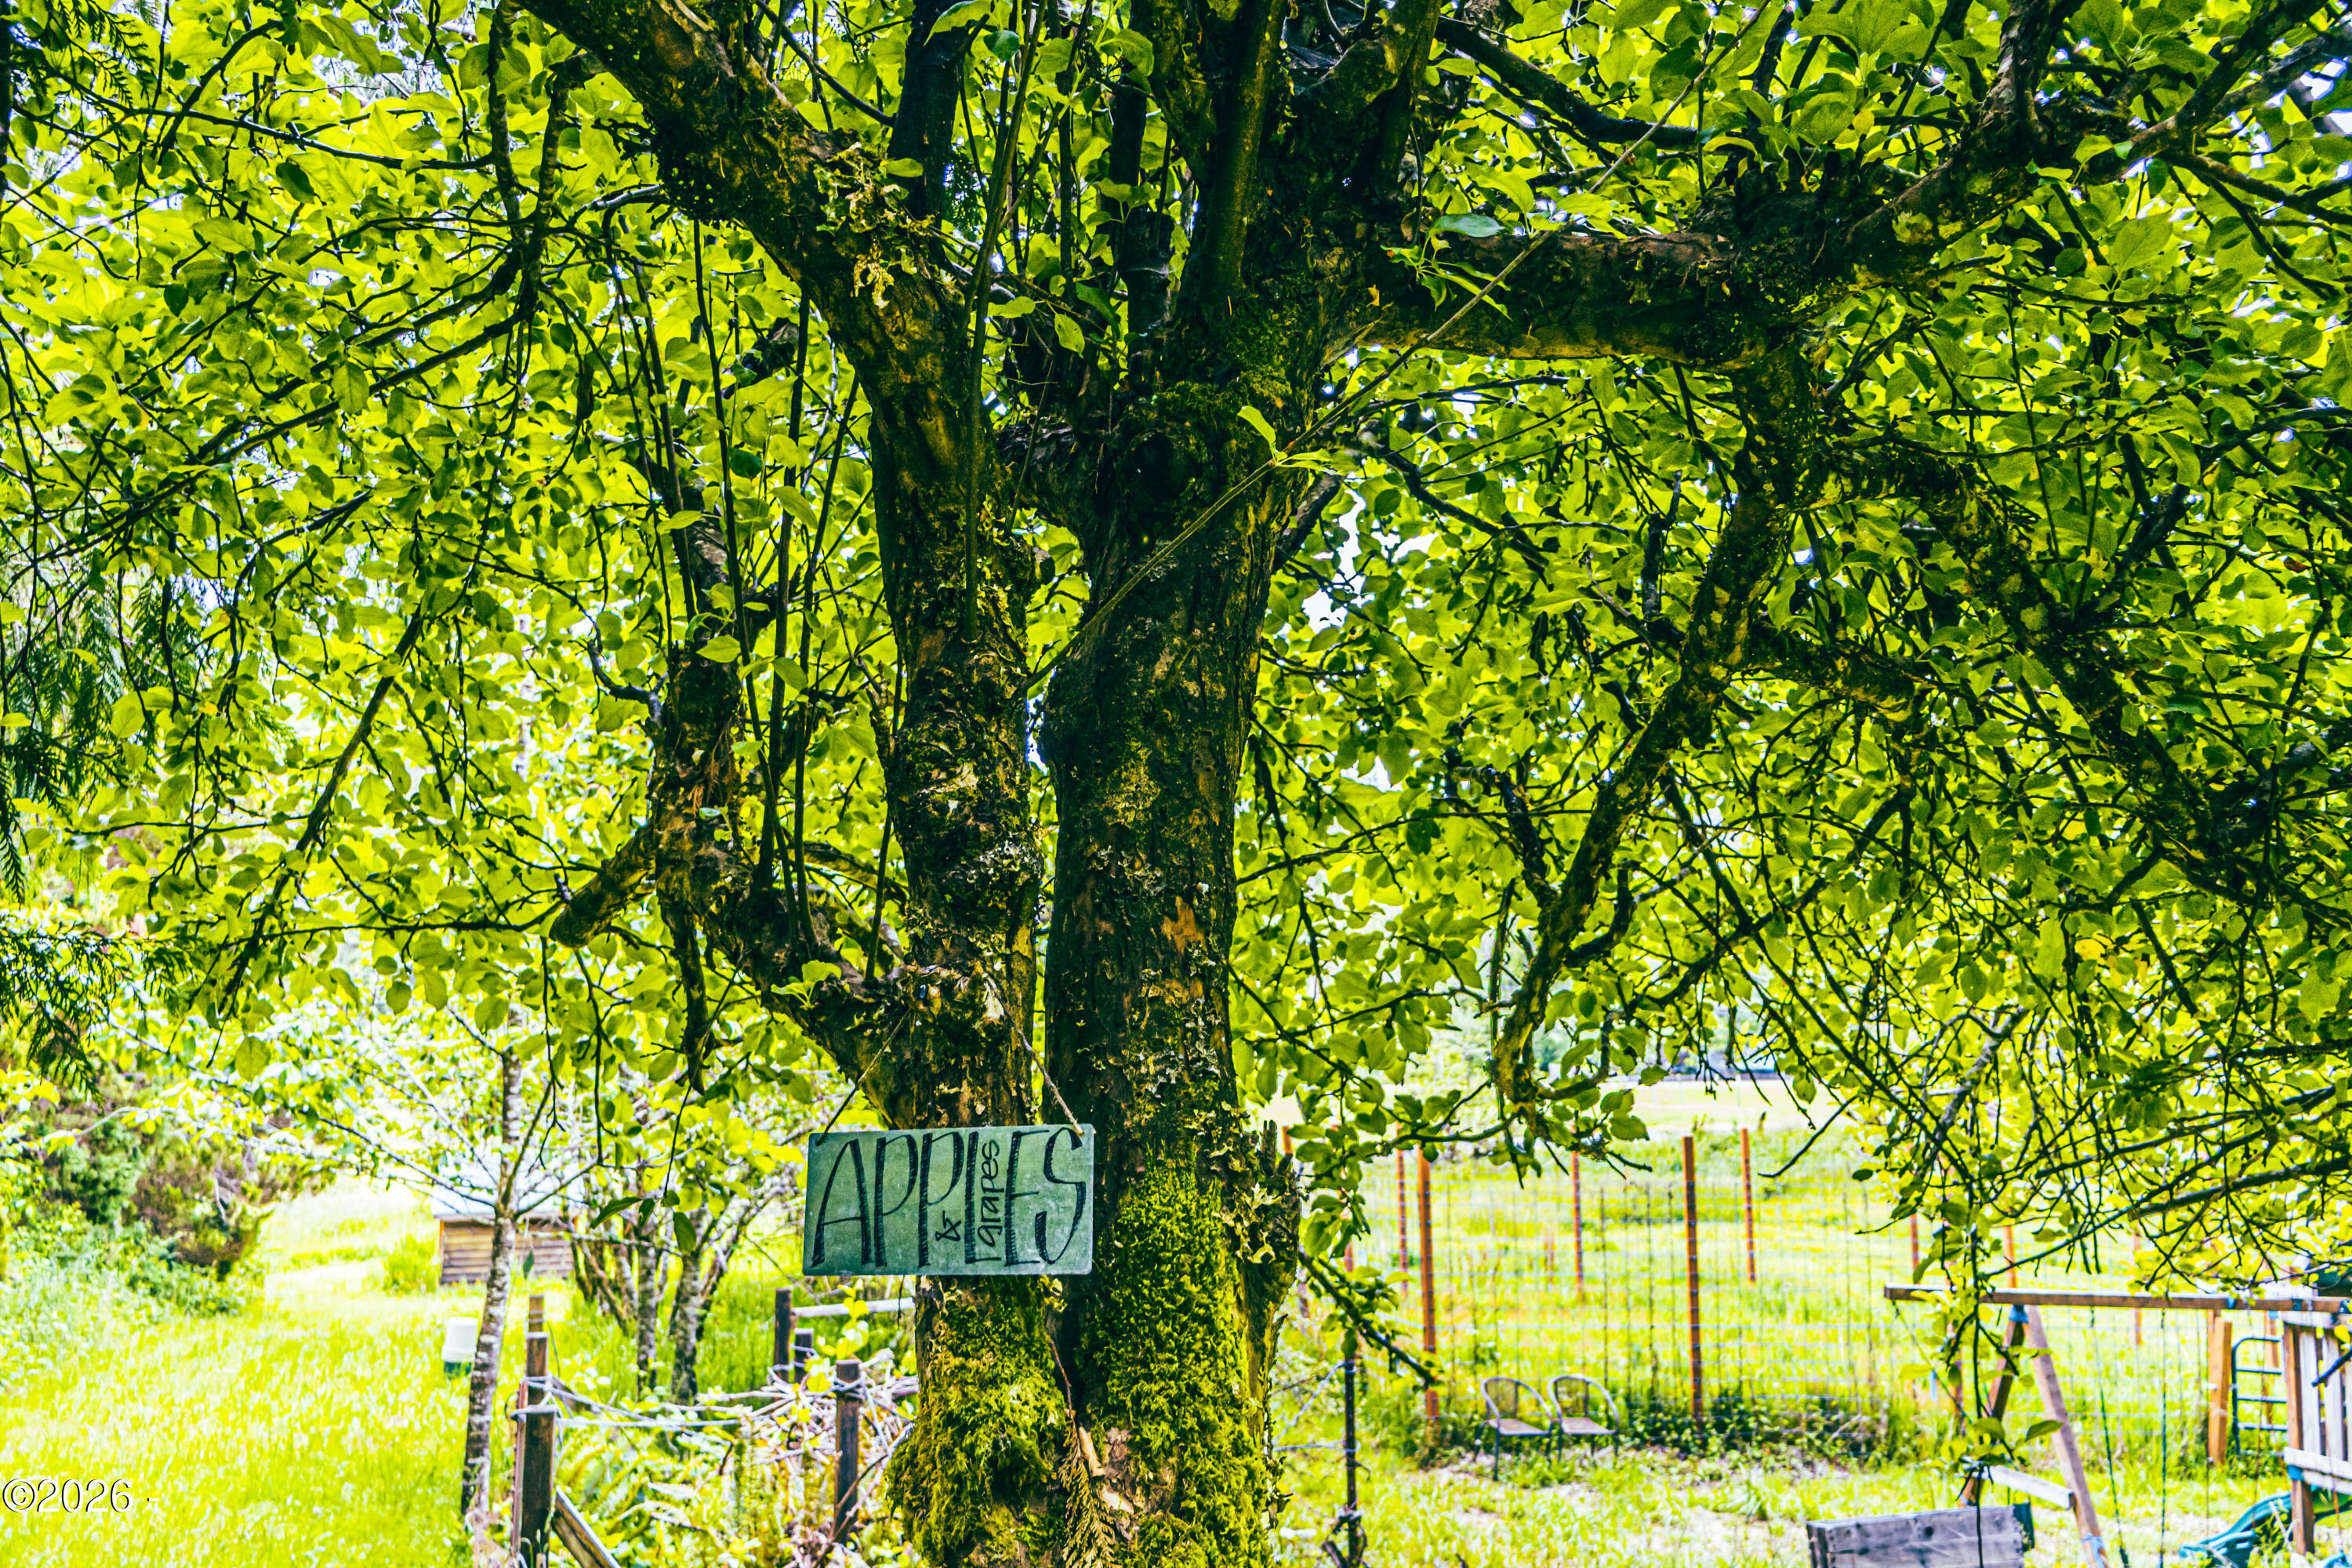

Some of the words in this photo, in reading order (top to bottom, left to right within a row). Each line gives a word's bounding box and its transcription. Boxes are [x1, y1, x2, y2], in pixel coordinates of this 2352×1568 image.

[811, 1127, 1087, 1268] APPLES
[935, 1210, 963, 1242] &
[977, 1138, 1005, 1247] grapes
